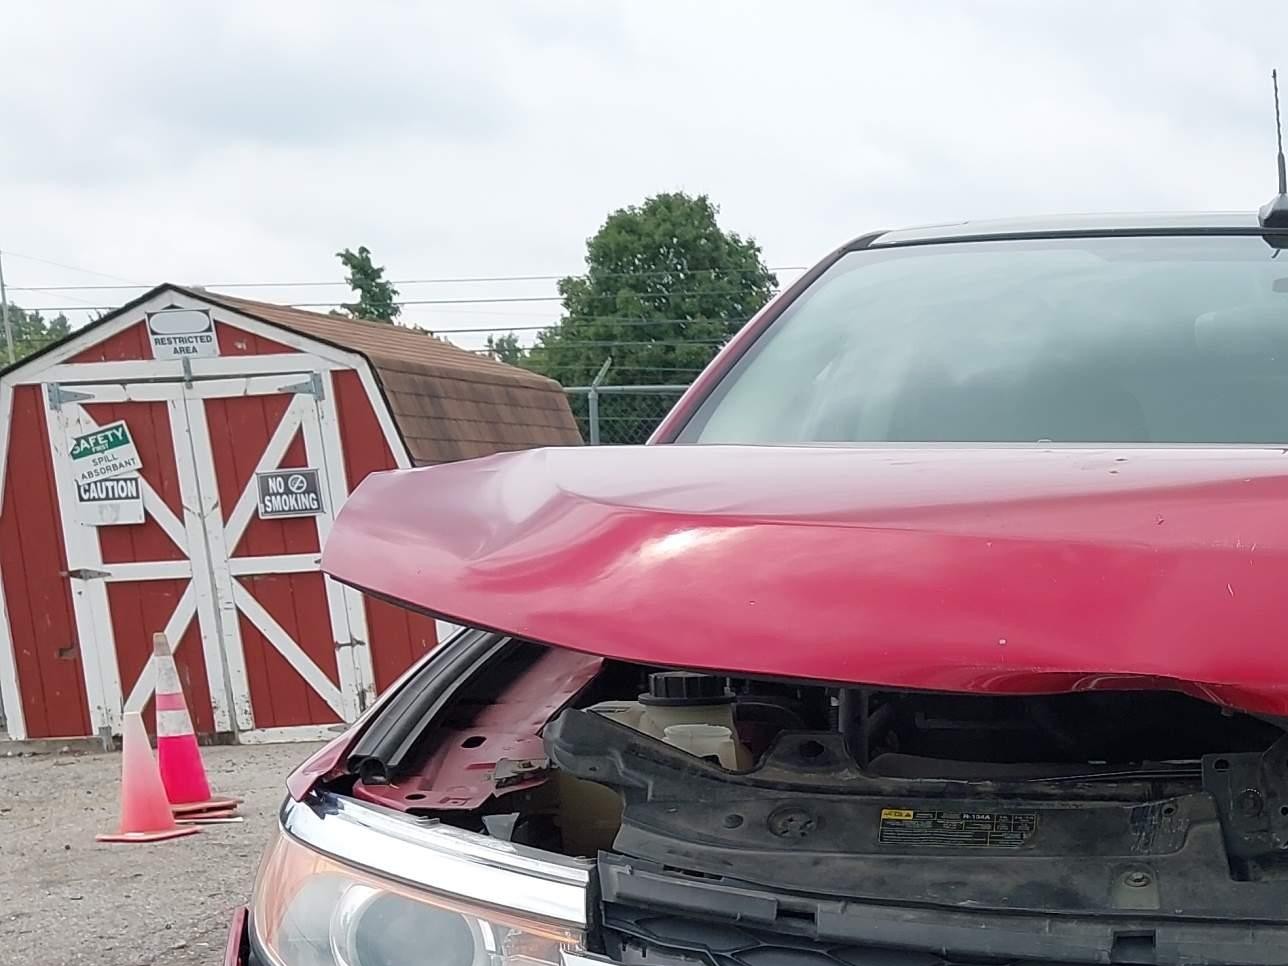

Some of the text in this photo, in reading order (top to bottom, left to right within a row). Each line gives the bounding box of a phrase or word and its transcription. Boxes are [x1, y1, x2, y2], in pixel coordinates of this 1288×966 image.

[154, 335, 213, 346] RESTRICTED
[173, 346, 198, 355] AREA
[72, 427, 123, 455] SAFETY
[81, 457, 136, 480] ABSORBANT
[91, 454, 119, 467] SPILL
[80, 480, 137, 500] CAUTION
[268, 476, 285, 494] NO
[264, 492, 319, 512] SMOKING
